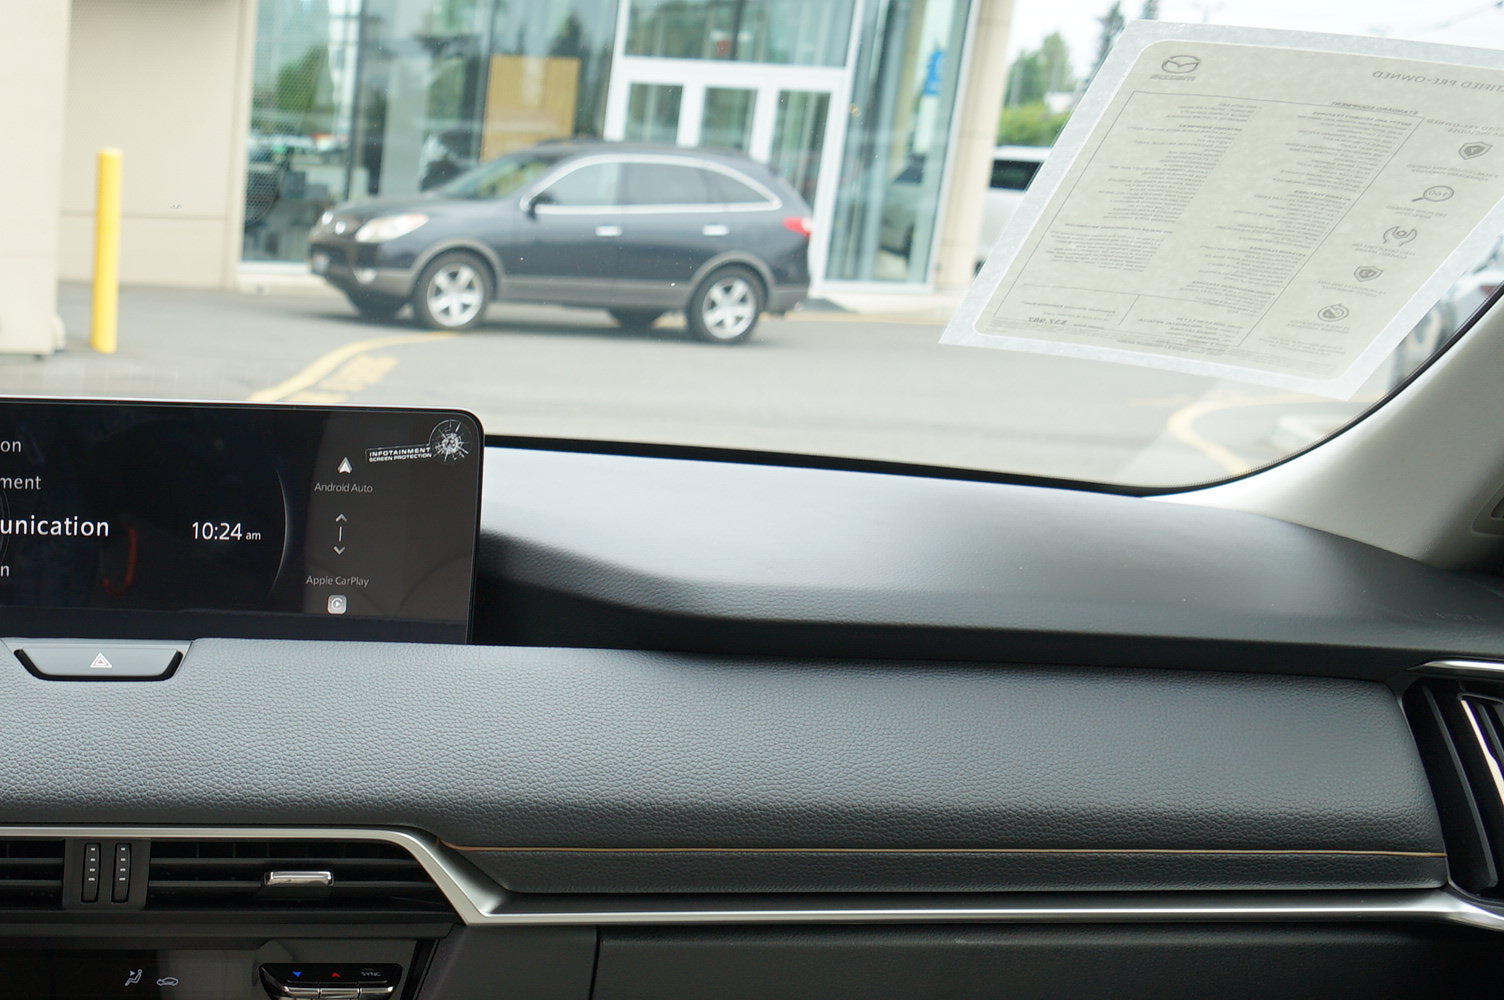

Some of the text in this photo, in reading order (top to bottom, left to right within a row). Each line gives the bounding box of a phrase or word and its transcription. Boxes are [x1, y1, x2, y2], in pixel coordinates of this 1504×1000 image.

[369, 447, 431, 457] INFOTAINMENT
[369, 452, 432, 463] SCREEN PROTECTION
[314, 482, 373, 493] Android Auto
[192, 522, 261, 540] 10:24 am
[306, 576, 369, 588] Apple CarPlay
